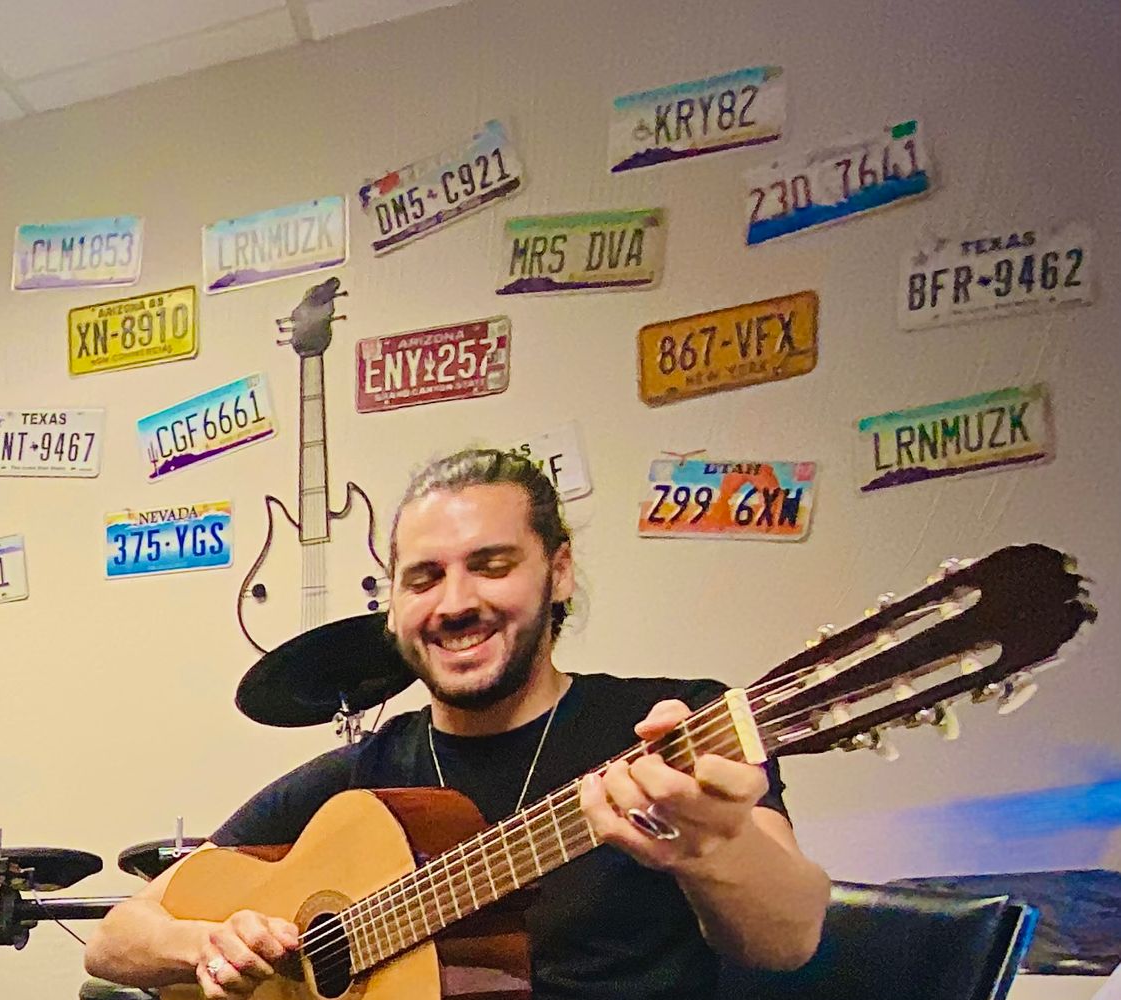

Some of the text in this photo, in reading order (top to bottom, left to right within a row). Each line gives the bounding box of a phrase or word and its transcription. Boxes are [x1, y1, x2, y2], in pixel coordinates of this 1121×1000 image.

[655, 84, 759, 145] KRY82
[31, 232, 134, 273] CLM1853
[509, 228, 645, 277] MRS DVA
[993, 247, 1084, 297] 9462
[76, 303, 189, 359] XN-8910
[398, 329, 465, 350] ARIZONA
[658, 310, 797, 375] 867-VFX
[364, 348, 423, 394] ENY
[21, 412, 67, 425] TEXAS
[155, 389, 266, 458] CGF6661
[872, 402, 1031, 472] LRNMUZK
[39, 432, 96, 462] 9467
[138, 505, 199, 524] NEVADA
[647, 484, 714, 525] Z99
